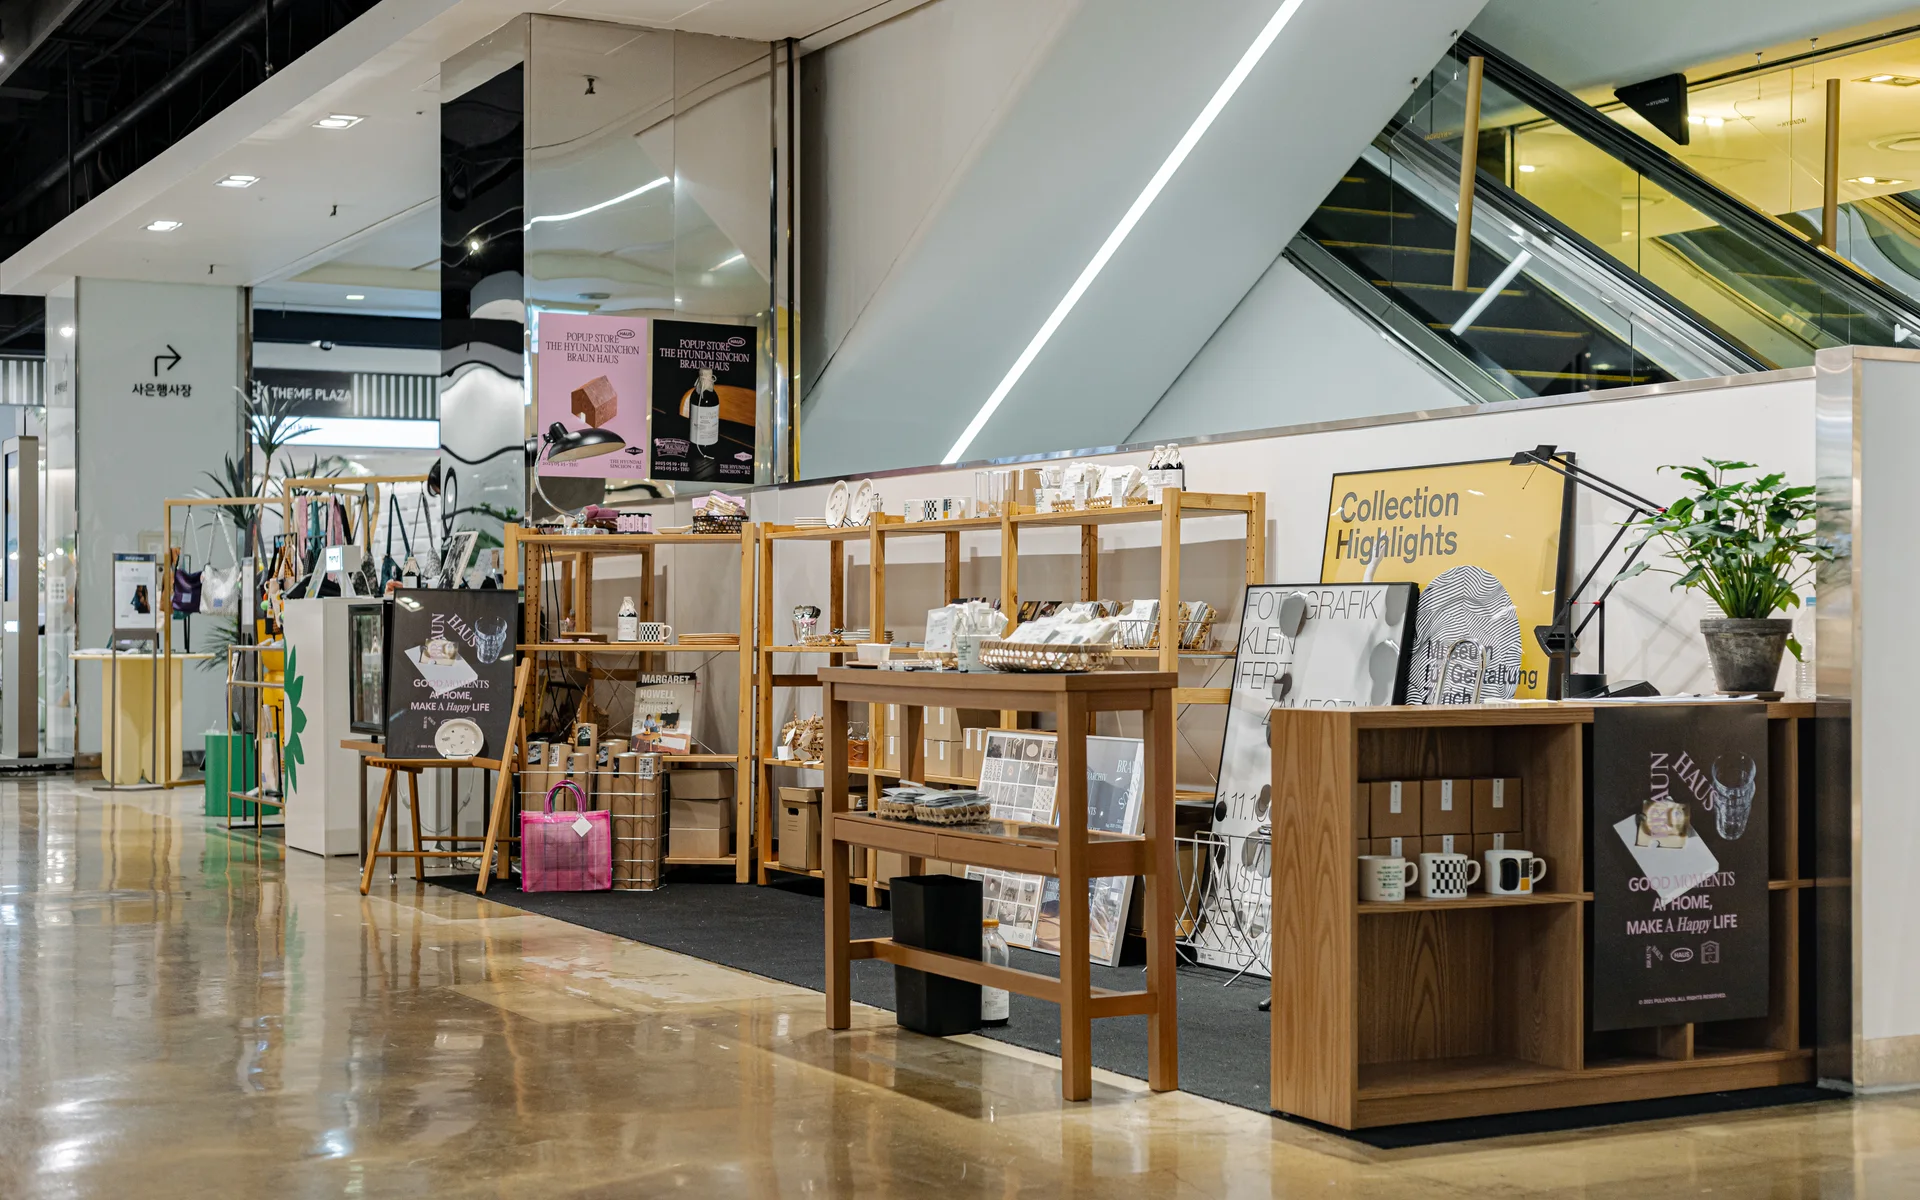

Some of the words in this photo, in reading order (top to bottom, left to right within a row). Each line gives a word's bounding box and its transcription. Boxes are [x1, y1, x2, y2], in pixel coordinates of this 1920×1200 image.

[566, 332, 594, 342] POPUP
[594, 334, 620, 344] STORE
[680, 339, 705, 349] POPUP
[706, 341, 731, 351] STORE
[546, 341, 562, 351] THE
[564, 342, 603, 353] HYUNDAI
[604, 344, 640, 355] SINCHON
[659, 347, 676, 358] THE
[677, 349, 714, 360] HYUNDAI
[715, 351, 750, 363] SINCHON
[567, 353, 595, 363] BRAUN
[597, 354, 619, 364] HAUS
[680, 359, 707, 370] BRAUN
[708, 361, 730, 371] HAUS
[132, 383, 192, 398] 사은행사장
[315, 388, 352, 402] PLAZA
[1340, 486, 1459, 523] Collection
[1335, 524, 1458, 566] Highlights
[1245, 589, 1382, 620] FOTGRAFIK
[446, 614, 480, 647] HAUS
[1240, 626, 1297, 655] KLEIN
[641, 674, 690, 685] MARGARET
[1426, 663, 1441, 683] fü
[1452, 662, 1538, 690] Getaltung
[442, 691, 473, 701] HOME,
[640, 689, 676, 699] HOWELL
[1422, 686, 1472, 705] Zrich
[410, 702, 436, 711] MAKE
[438, 703, 445, 711] A
[446, 703, 472, 713] Happy
[472, 703, 490, 712] LIFE
[639, 704, 673, 714] HOUSES
[1671, 750, 1720, 811] HAUS
[1628, 876, 1671, 892] GOOD
[1672, 871, 1736, 889] MOMENTS
[1671, 894, 1713, 911] HOME,
[1626, 919, 1664, 935] MAKE
[1665, 918, 1674, 932] A
[1677, 916, 1712, 935] Happy
[1713, 914, 1738, 929] LIFE
